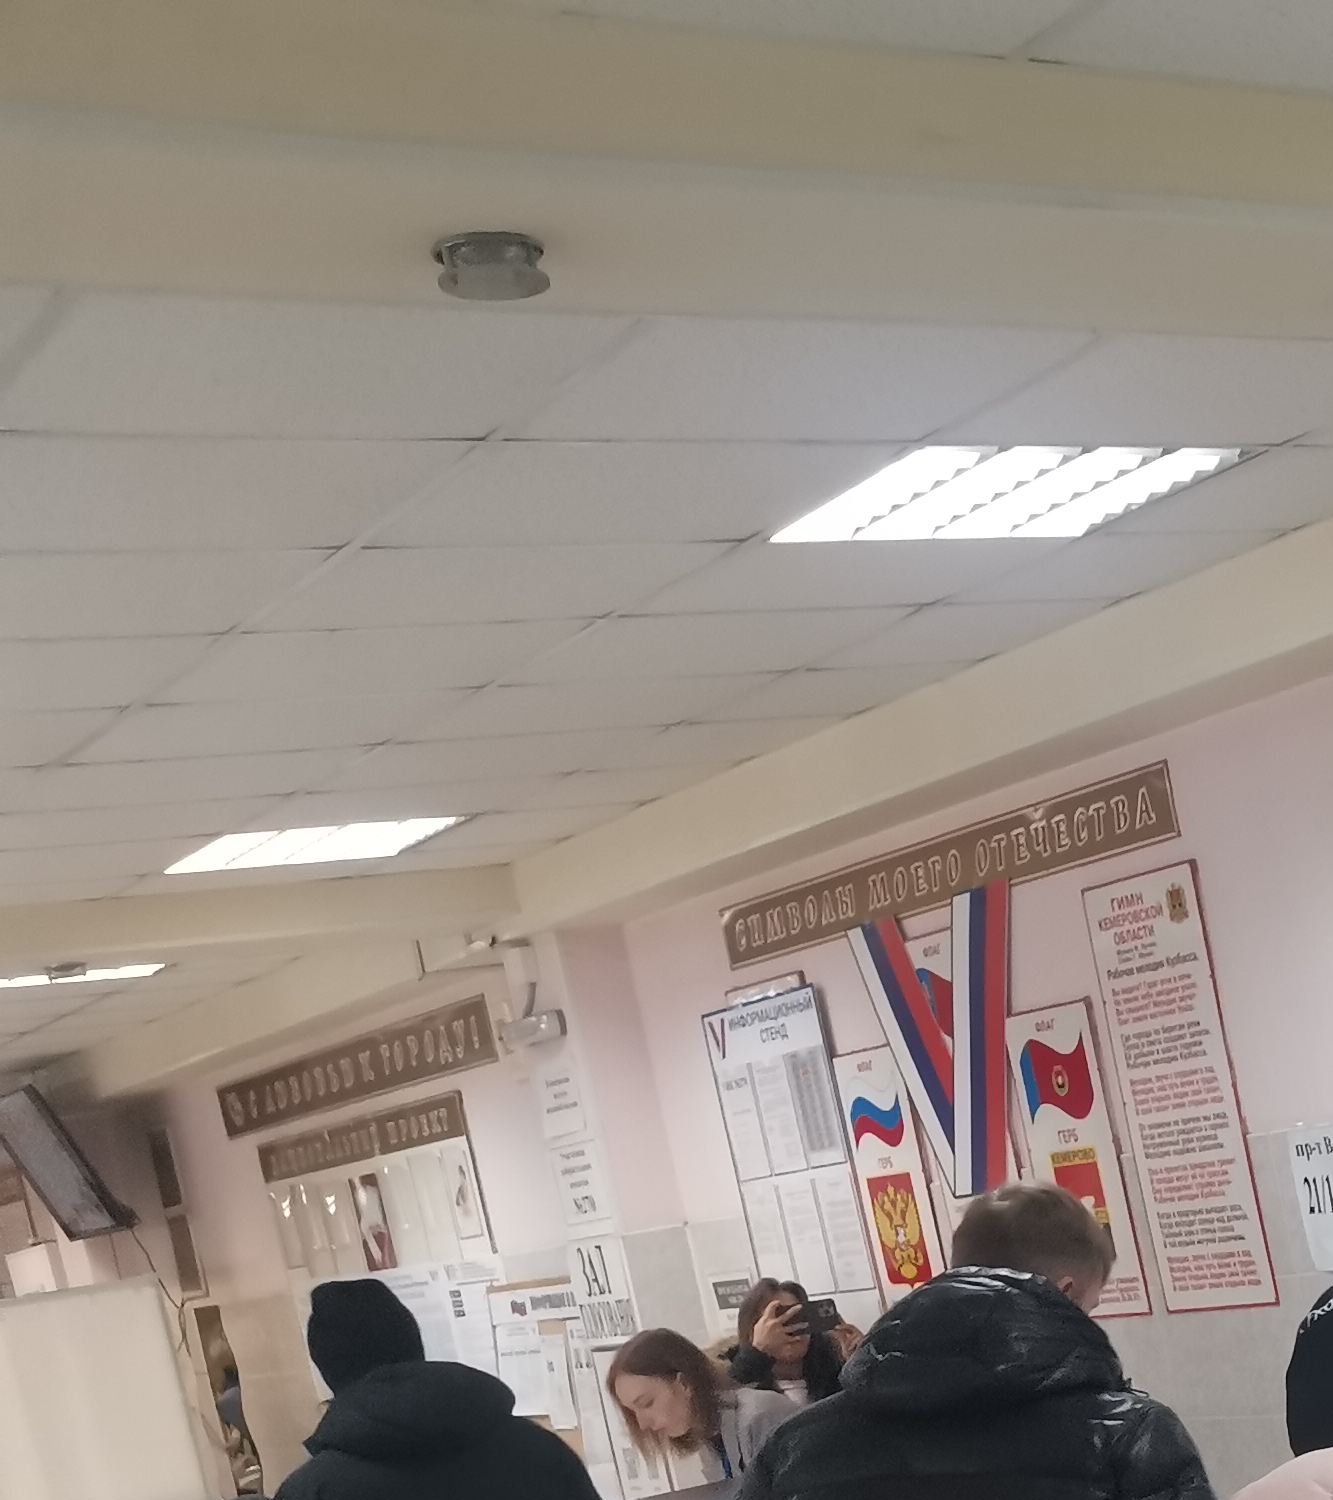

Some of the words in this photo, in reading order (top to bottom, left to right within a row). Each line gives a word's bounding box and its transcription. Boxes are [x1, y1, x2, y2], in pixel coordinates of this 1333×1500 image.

[735, 883, 856, 953] СИМВОЛЫ
[868, 848, 962, 912] МОЕГО
[975, 785, 1158, 877] ОТЕЧЕСТВА
[1110, 891, 1145, 913] ГИМН
[1097, 902, 1165, 933] КЕМЕРОВСКОЙ
[1113, 924, 1156, 947] ОБЛАСТИ
[728, 991, 814, 1032] ИНФОРМАЦИОННЫЙ
[759, 1022, 790, 1044] СТЕНД
[1295, 1138, 1323, 1159] пр-т
[576, 1244, 613, 1298] ЗАЛ
